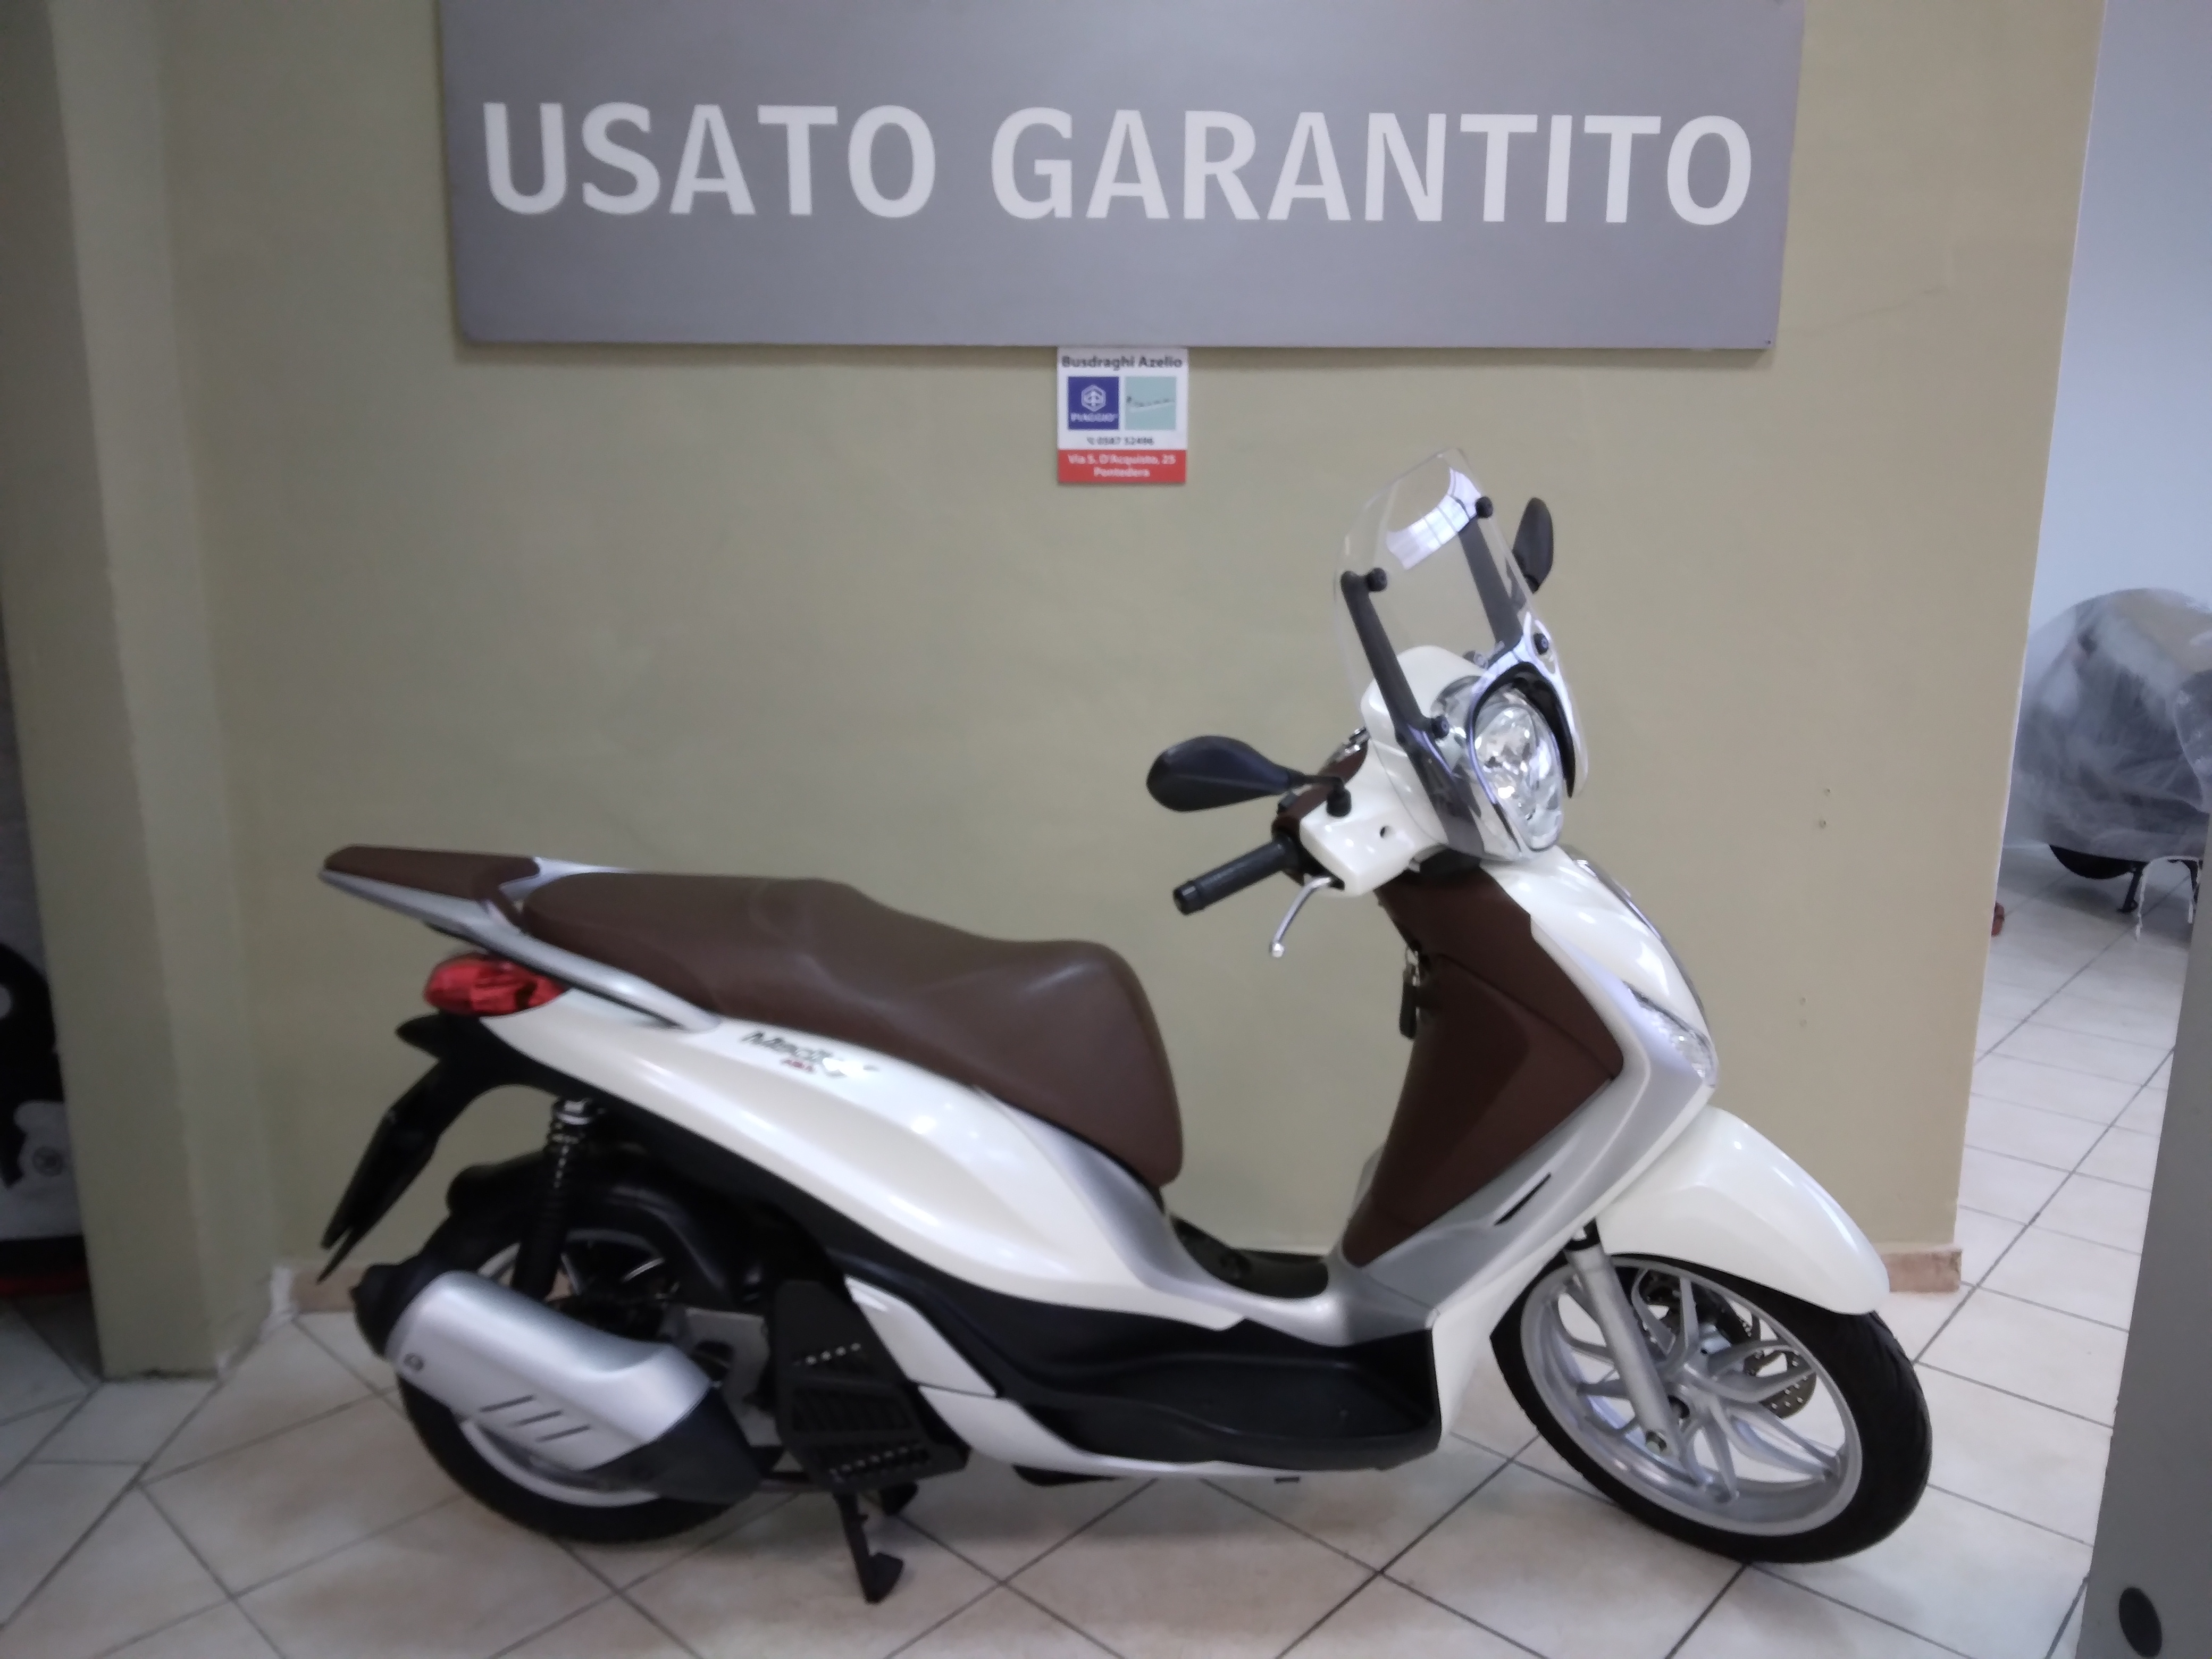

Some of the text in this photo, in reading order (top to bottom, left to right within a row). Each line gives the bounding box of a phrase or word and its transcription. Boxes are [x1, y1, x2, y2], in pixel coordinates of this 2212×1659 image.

[483, 102, 1752, 225] USATO GARANTITO
[1062, 355, 1183, 371] Busdraghi Azelio
[1068, 454, 1086, 464] Via
